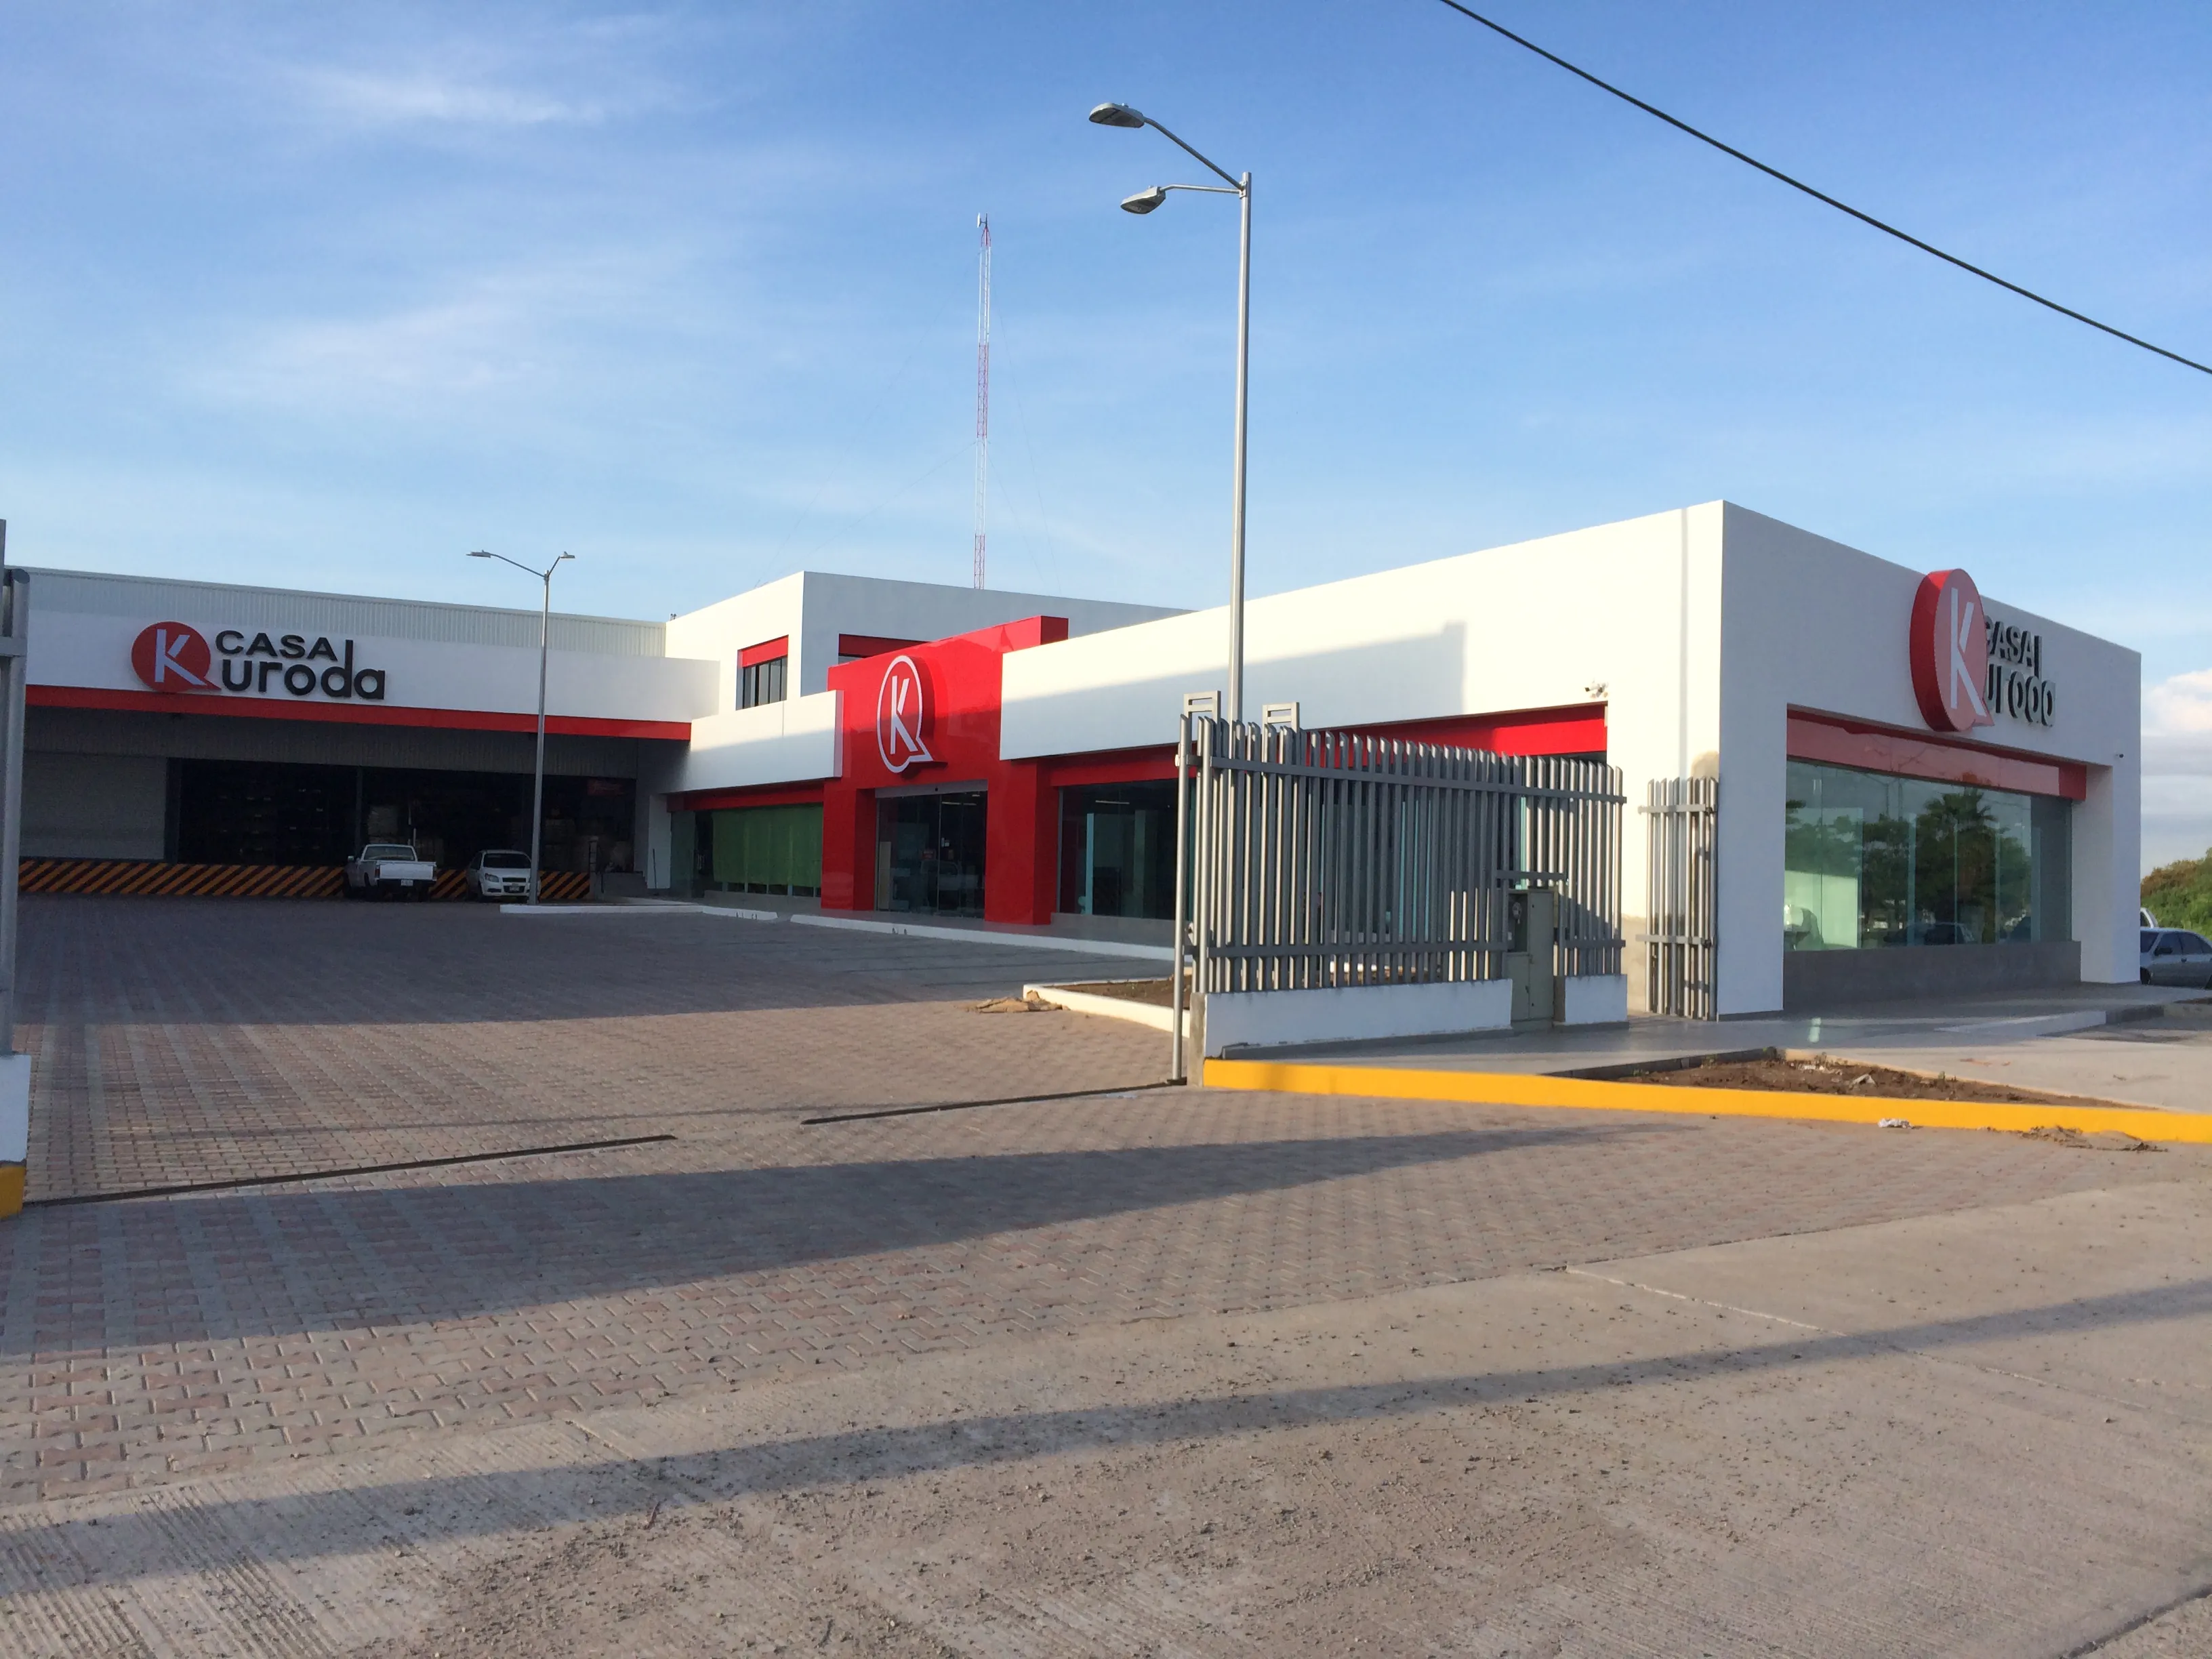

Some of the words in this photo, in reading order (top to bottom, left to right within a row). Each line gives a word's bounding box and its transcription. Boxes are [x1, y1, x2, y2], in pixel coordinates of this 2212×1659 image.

[155, 629, 207, 686] K
[216, 630, 337, 661] CASA
[1950, 588, 1986, 716] K
[890, 675, 918, 754] K
